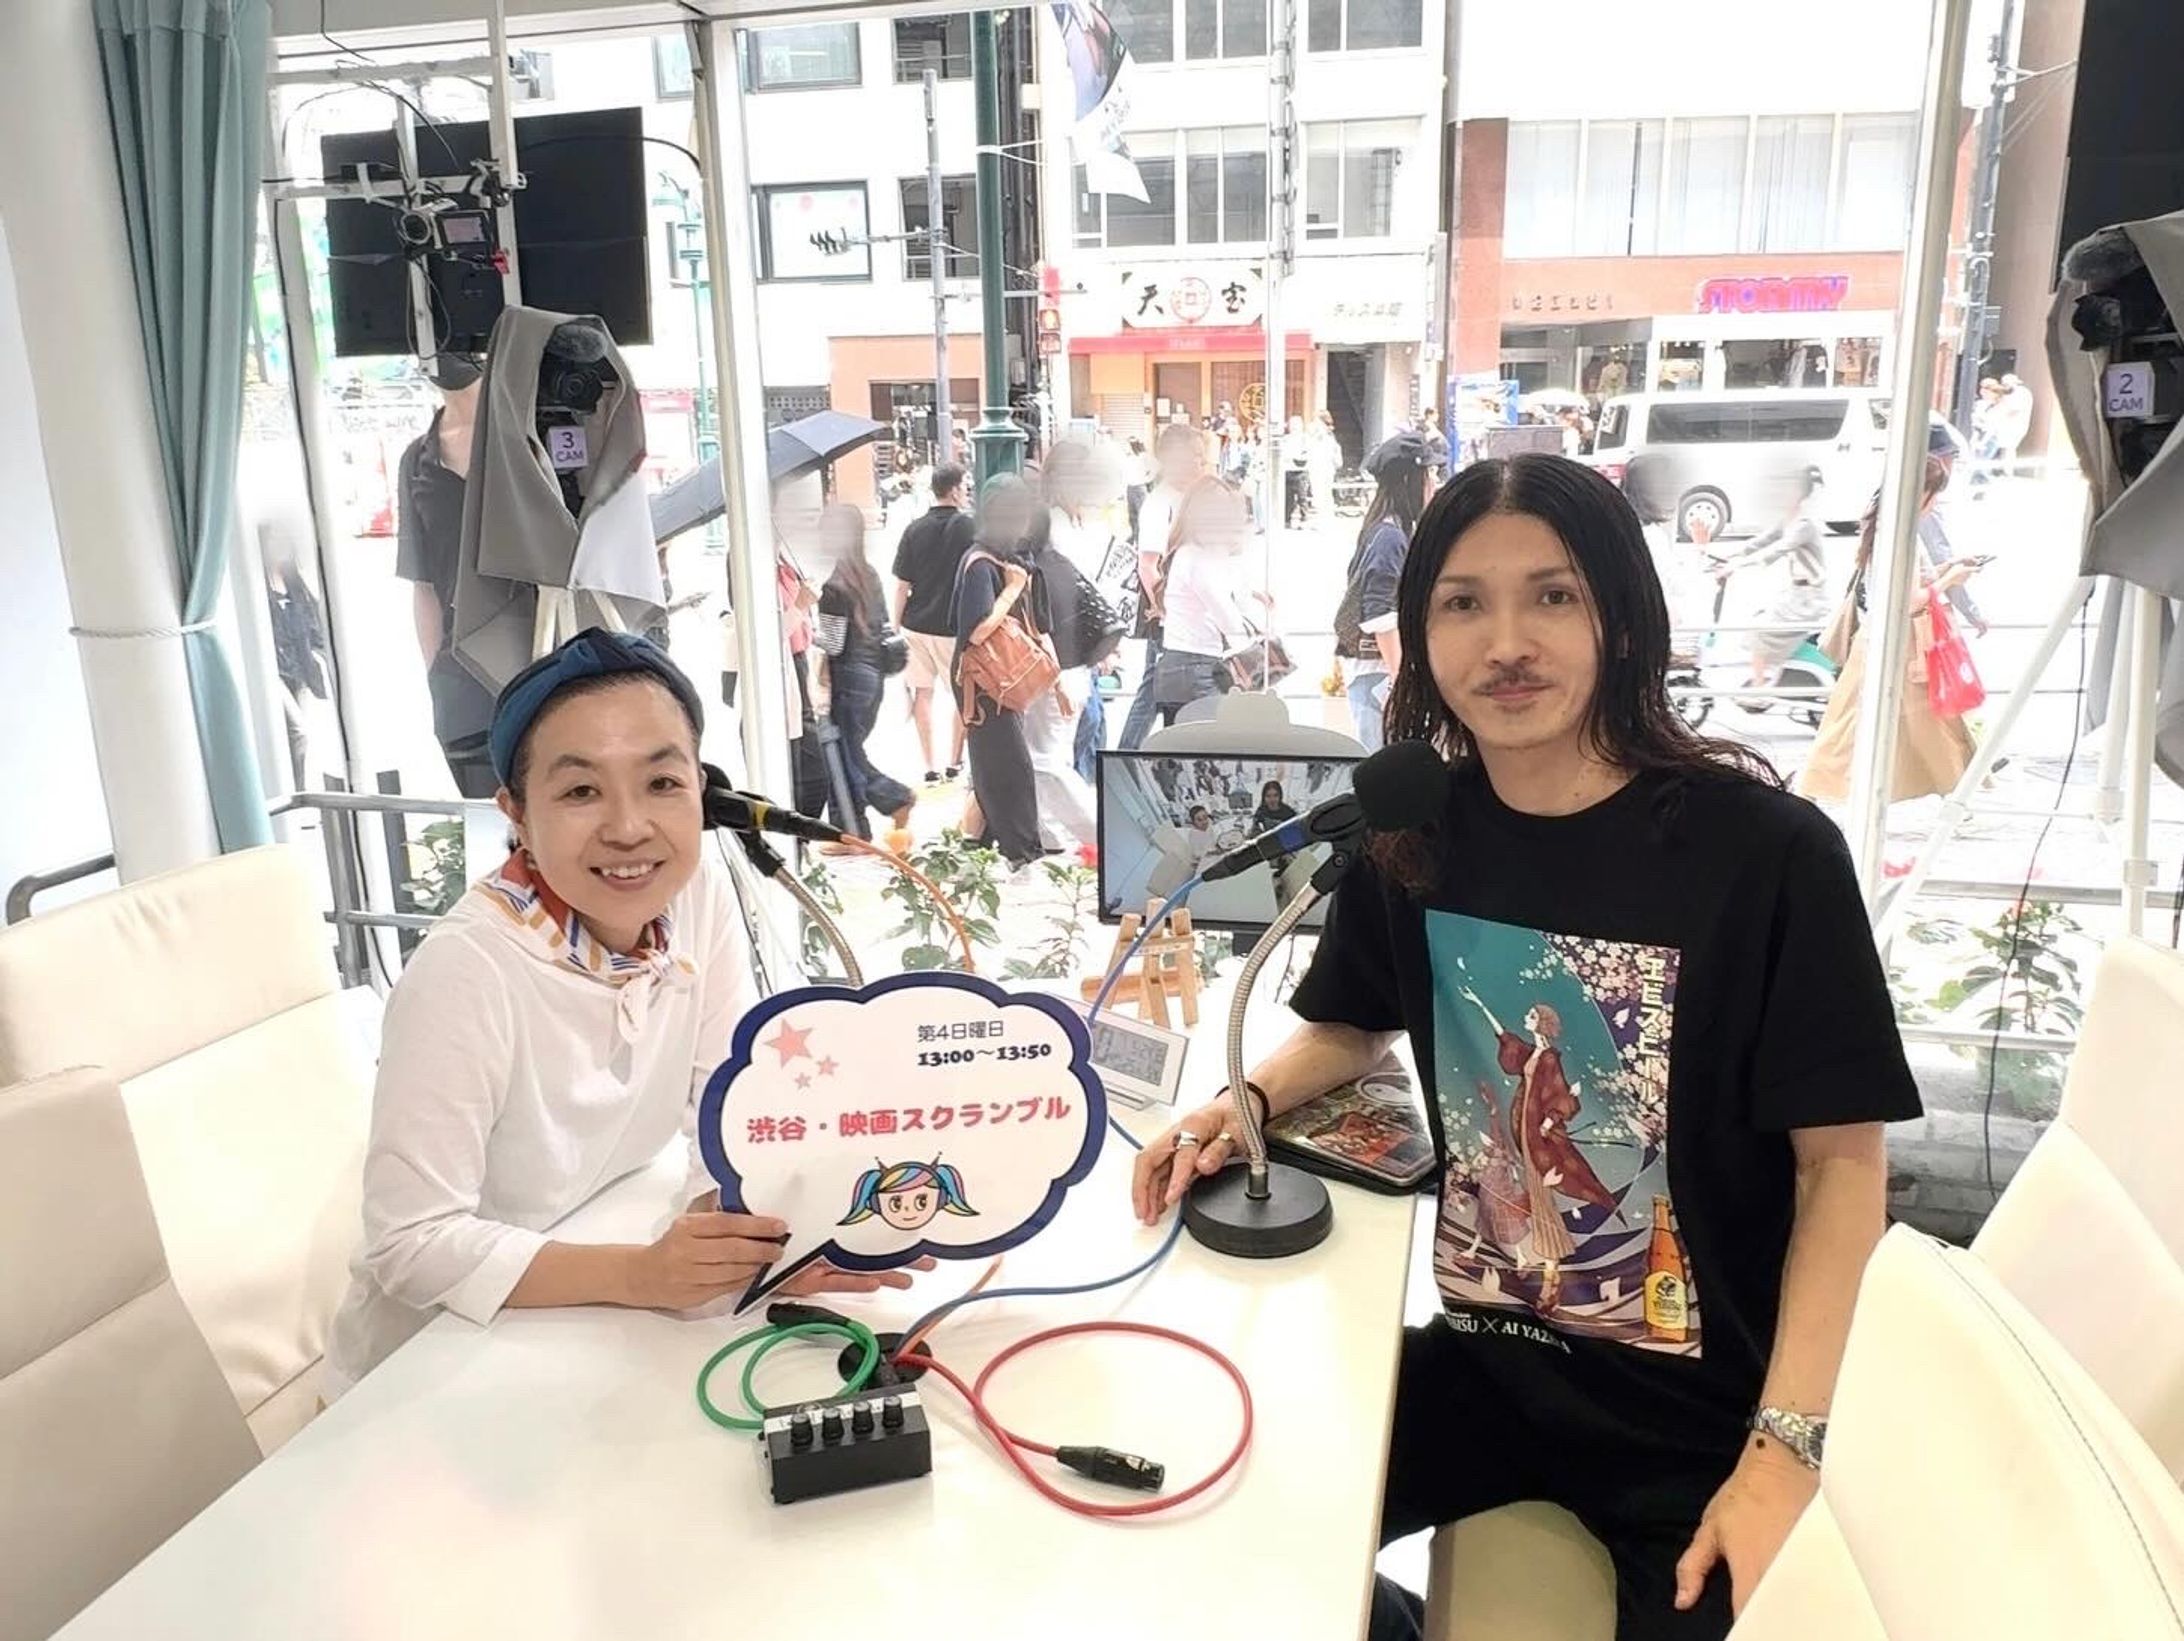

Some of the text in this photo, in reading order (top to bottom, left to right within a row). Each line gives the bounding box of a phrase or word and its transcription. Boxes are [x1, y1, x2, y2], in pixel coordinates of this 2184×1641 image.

[2119, 373, 2133, 394] 2
[2109, 397, 2144, 412] CAM
[561, 431, 575, 449] 3
[556, 450, 584, 462] CAM
[917, 1020, 1004, 1043] 第4日曜日
[747, 1096, 1071, 1143] 渋谷・映画スクランブル
[1501, 1321, 1518, 1335] AI
